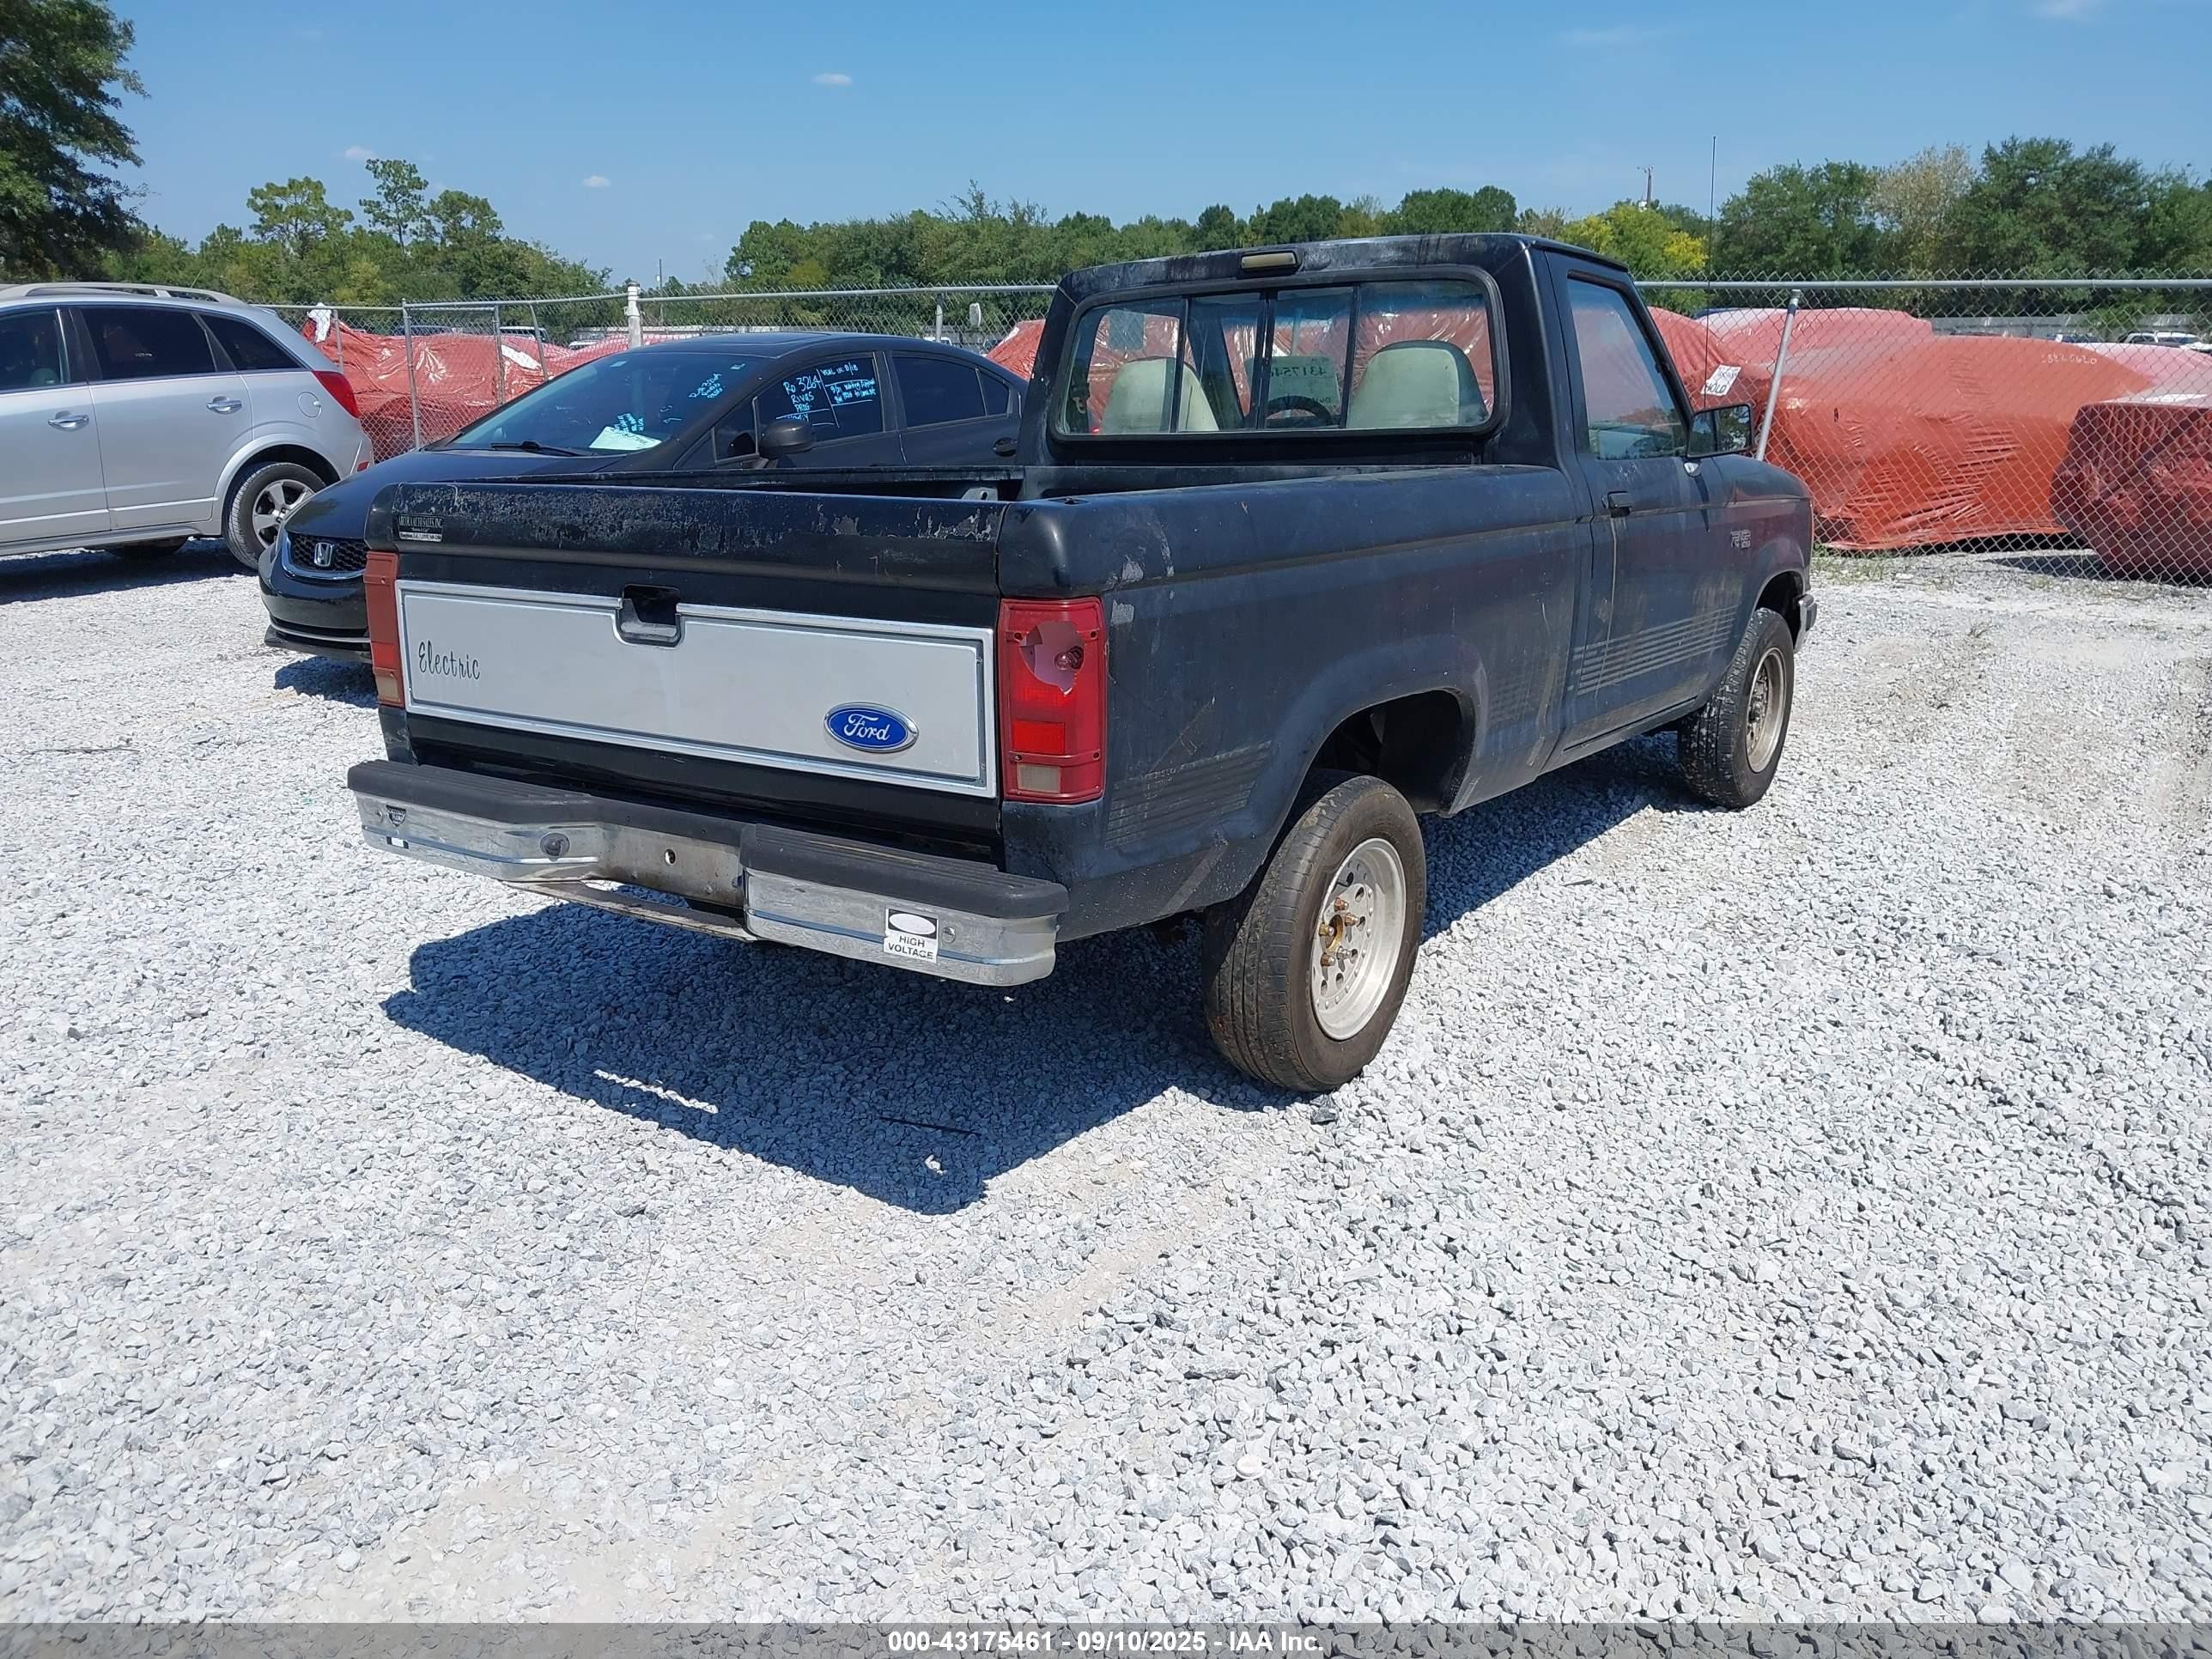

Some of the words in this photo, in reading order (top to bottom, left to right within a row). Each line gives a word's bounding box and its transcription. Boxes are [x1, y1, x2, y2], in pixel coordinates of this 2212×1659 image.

[418, 641, 481, 680] Electric
[843, 713, 891, 741] Ford
[888, 942, 934, 960] VOLTAGE
[898, 935, 926, 948] HIGH
